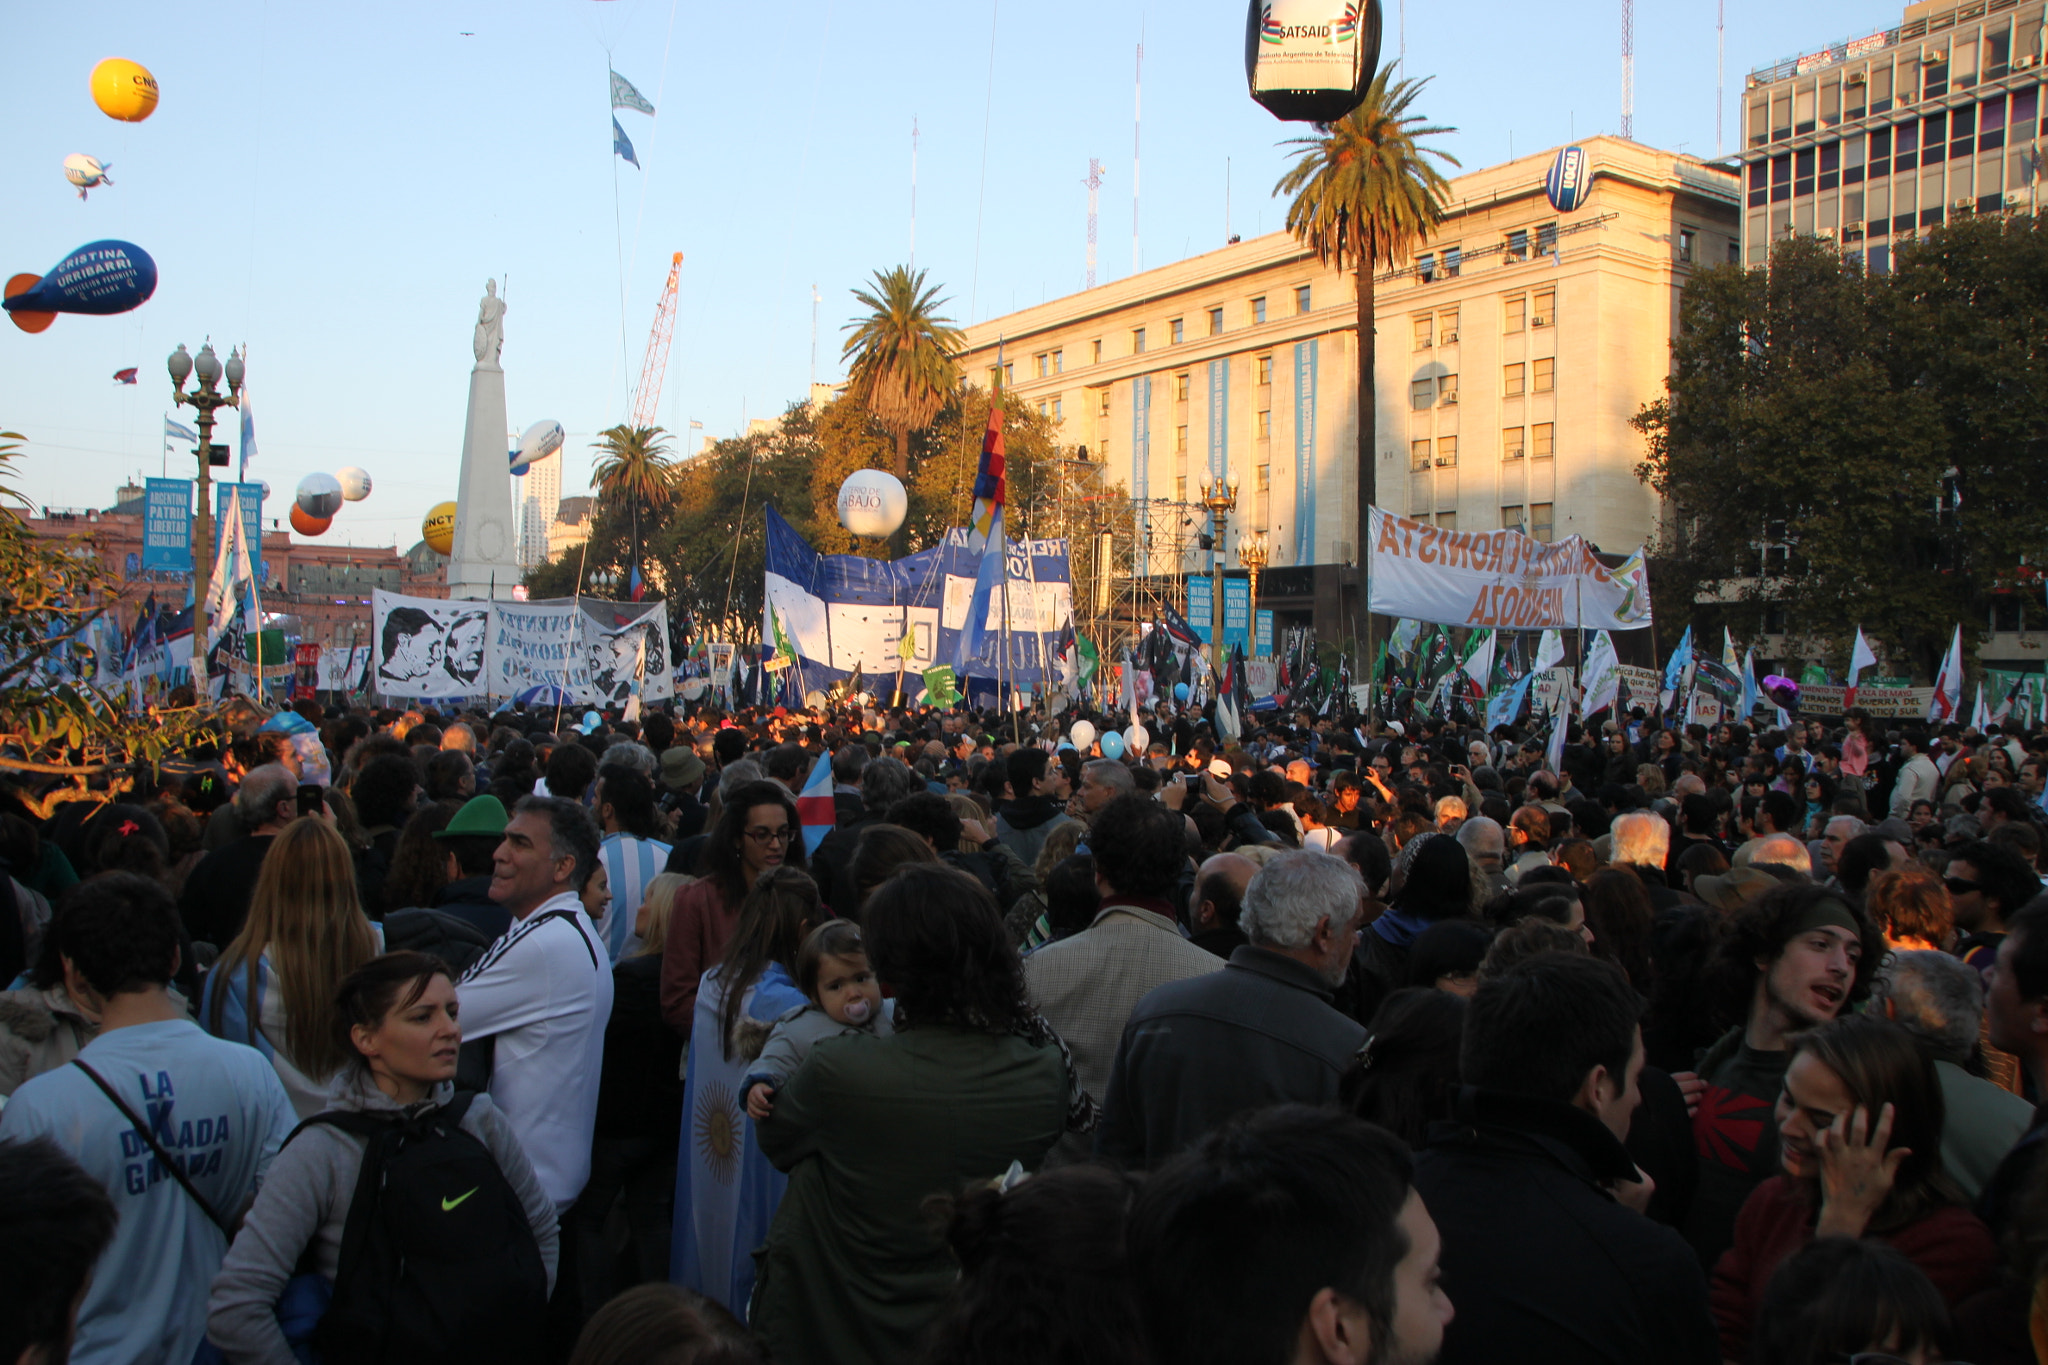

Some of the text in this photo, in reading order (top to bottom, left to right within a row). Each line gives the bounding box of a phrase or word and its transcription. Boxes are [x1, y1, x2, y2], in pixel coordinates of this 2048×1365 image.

[1280, 25, 1330, 39] SATSAID
[1562, 150, 1580, 189] UOCRA
[57, 249, 127, 273] CRISTINA
[57, 259, 132, 288] URRIBARRI
[150, 492, 187, 506] ARGENTINA
[150, 506, 187, 520] PATRIA
[149, 520, 187, 534] LIBERTAD
[148, 533, 187, 548] IGUALDAD
[1227, 599, 1247, 608] PATRIA
[1889, 689, 1912, 697] MAYO
[1858, 697, 1899, 706] GUERRA
[1903, 697, 1922, 706] DEL
[1829, 706, 1842, 714] DEL
[1899, 707, 1919, 715] SUR
[140, 1070, 174, 1100] LA
